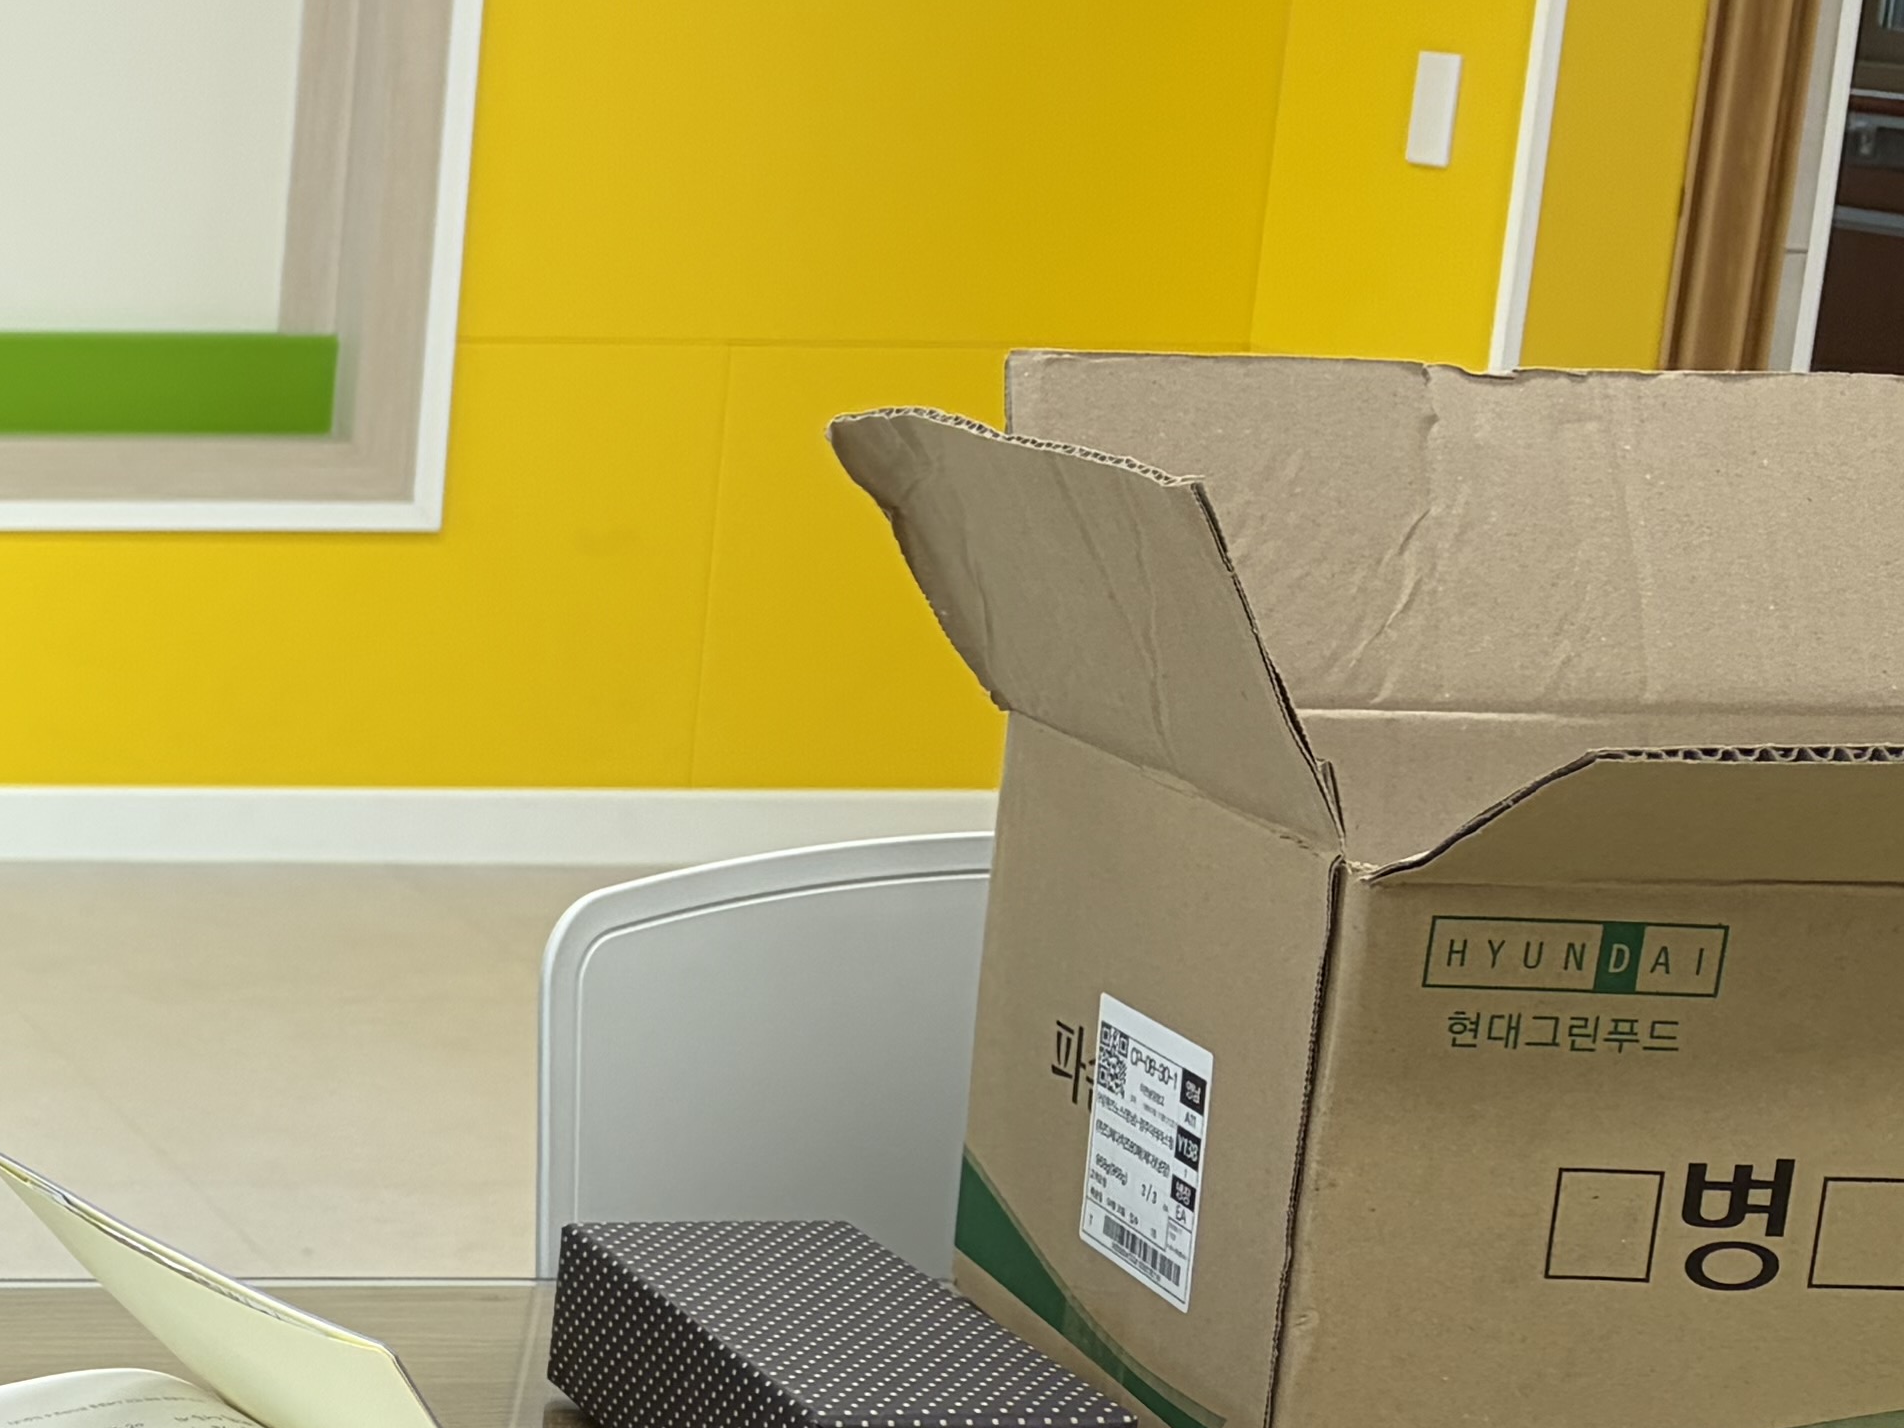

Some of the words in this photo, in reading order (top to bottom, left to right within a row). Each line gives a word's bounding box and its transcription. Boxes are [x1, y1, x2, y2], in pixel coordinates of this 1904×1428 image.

[1447, 937, 1706, 977] HYUNDAI
[1446, 1010, 1683, 1055] 현대그린푸드
[1681, 1158, 1796, 1290] 병
